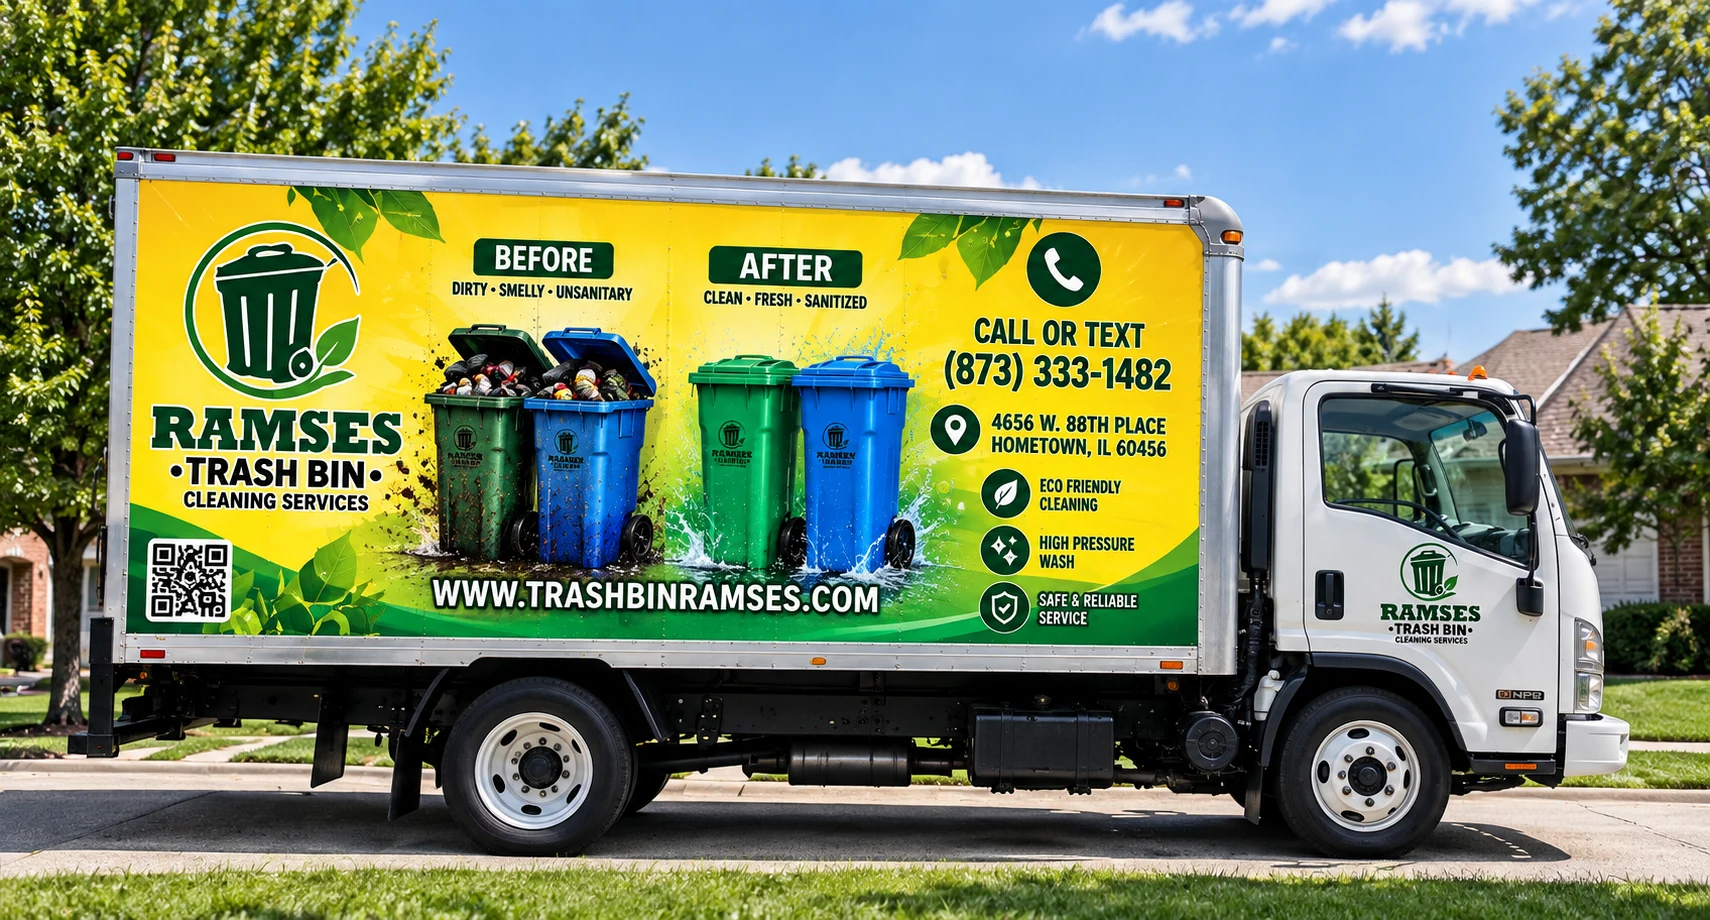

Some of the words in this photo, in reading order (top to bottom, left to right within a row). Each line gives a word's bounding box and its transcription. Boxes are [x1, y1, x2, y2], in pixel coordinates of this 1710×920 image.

[495, 244, 593, 273] BEFORE
[739, 252, 833, 282] AFTER
[452, 281, 488, 296] DIRTY
[499, 283, 545, 298] SMELLY
[556, 285, 633, 301] UNSANITARY
[704, 290, 743, 305] CLEAN
[755, 292, 793, 307] FRESH
[804, 294, 868, 309] SANITIZED
[974, 317, 1035, 345] CALL
[1042, 319, 1077, 346] OR
[1085, 321, 1145, 348] TEXT
[944, 350, 1024, 392] (873)
[1033, 354, 1172, 391] 333-1482
[151, 406, 403, 455] RAMSES
[991, 413, 1034, 431] 4656
[1040, 414, 1060, 432] W.
[1066, 415, 1109, 433] 88TH
[1114, 416, 1166, 435] PLACE
[991, 436, 1092, 458] HOMETOWN,
[1097, 439, 1111, 456] IL
[1116, 440, 1167, 457] 60456
[1040, 478, 1063, 493] ECO
[1066, 479, 1122, 494] FRIENDLY
[183, 491, 276, 509] CLEANING
[282, 493, 369, 511] SERVICES
[1039, 497, 1098, 512] CLEANING
[1039, 535, 1069, 550] HIGH
[1073, 536, 1135, 551] PRESSURE
[1039, 554, 1075, 569] WASH
[432, 579, 879, 613] WWW.TRASHBINRAMSES.COM
[1039, 593, 1068, 607] SAFE
[1071, 593, 1080, 607] &
[1083, 594, 1137, 608] RELIABLE
[1039, 611, 1088, 625] SERVICE
[1380, 603, 1481, 622] RAMSES
[1395, 636, 1432, 644] CLEANING
[1434, 637, 1468, 645] SERVICES
